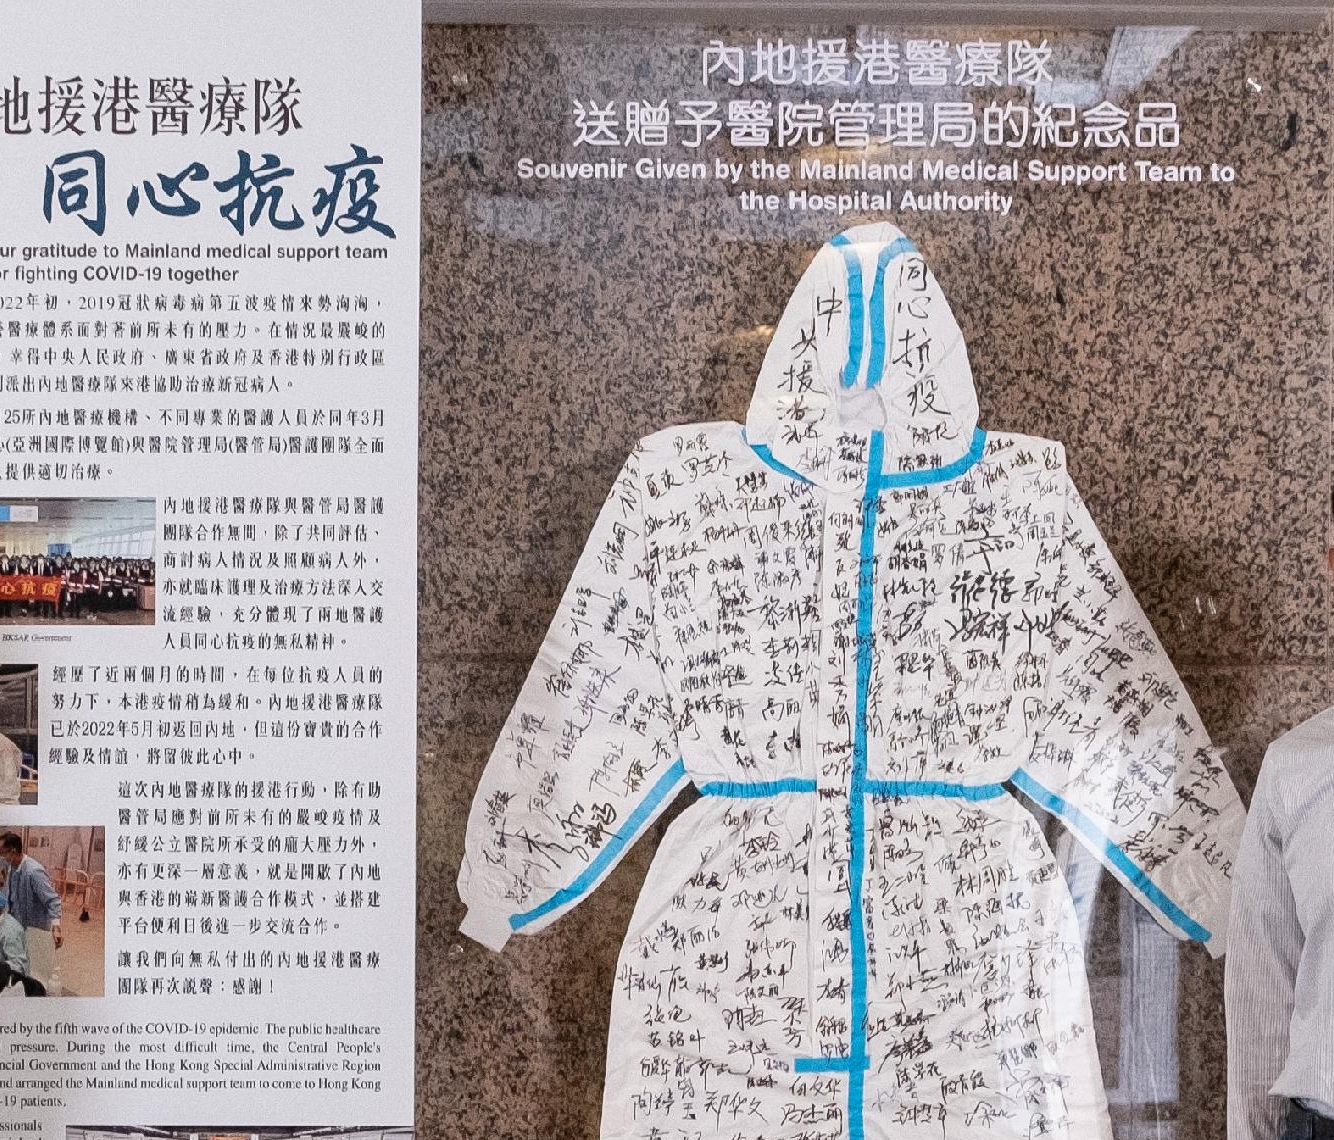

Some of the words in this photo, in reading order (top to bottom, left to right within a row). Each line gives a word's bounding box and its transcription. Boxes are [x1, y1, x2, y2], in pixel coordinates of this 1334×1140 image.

[700, 38, 1053, 88] 內地援港醫療隊
[572, 101, 1181, 149] 送贈予醫院管理局的紀念品
[517, 160, 628, 181] Souvenir
[635, 160, 707, 181] Given
[715, 160, 744, 187] by
[750, 160, 791, 181] the
[799, 160, 913, 181] Mainland
[922, 160, 1019, 182] Medical
[1028, 160, 1127, 188] Support
[1135, 161, 1203, 182] Team
[1210, 163, 1236, 183] to
[43, 143, 396, 240] 同心抗疫
[739, 191, 779, 210] the
[788, 191, 893, 216] Hospital
[900, 191, 1014, 216] Authority
[22, 244, 97, 263] gratitude
[104, 244, 118, 259] to
[126, 244, 200, 259] Mainland
[207, 244, 271, 259] medical
[278, 244, 339, 263] support
[346, 244, 387, 259] team
[16, 266, 77, 285] fighting
[84, 266, 161, 281] COVID-19
[168, 266, 236, 285] together
[20, 1022, 32, 1037] by
[36, 1022, 51, 1034] the
[55, 1022, 77, 1034] fifth
[82, 1026, 109, 1034] wave
[112, 1022, 123, 1034] of
[127, 1022, 142, 1034] the
[146, 1022, 206, 1034] COVID-19
[267, 1022, 285, 1034] The
[289, 1022, 322, 1037] public
[326, 1022, 380, 1034] healthcare
[29, 1058, 96, 1070] Government
[101, 1058, 120, 1070] and
[125, 1058, 142, 1070] the
[145, 1058, 175, 1073] Hong
[180, 1058, 209, 1073] Kong
[214, 1058, 253, 1073] Special
[258, 1058, 337, 1070] Administrative
[342, 1058, 380, 1073] Region
